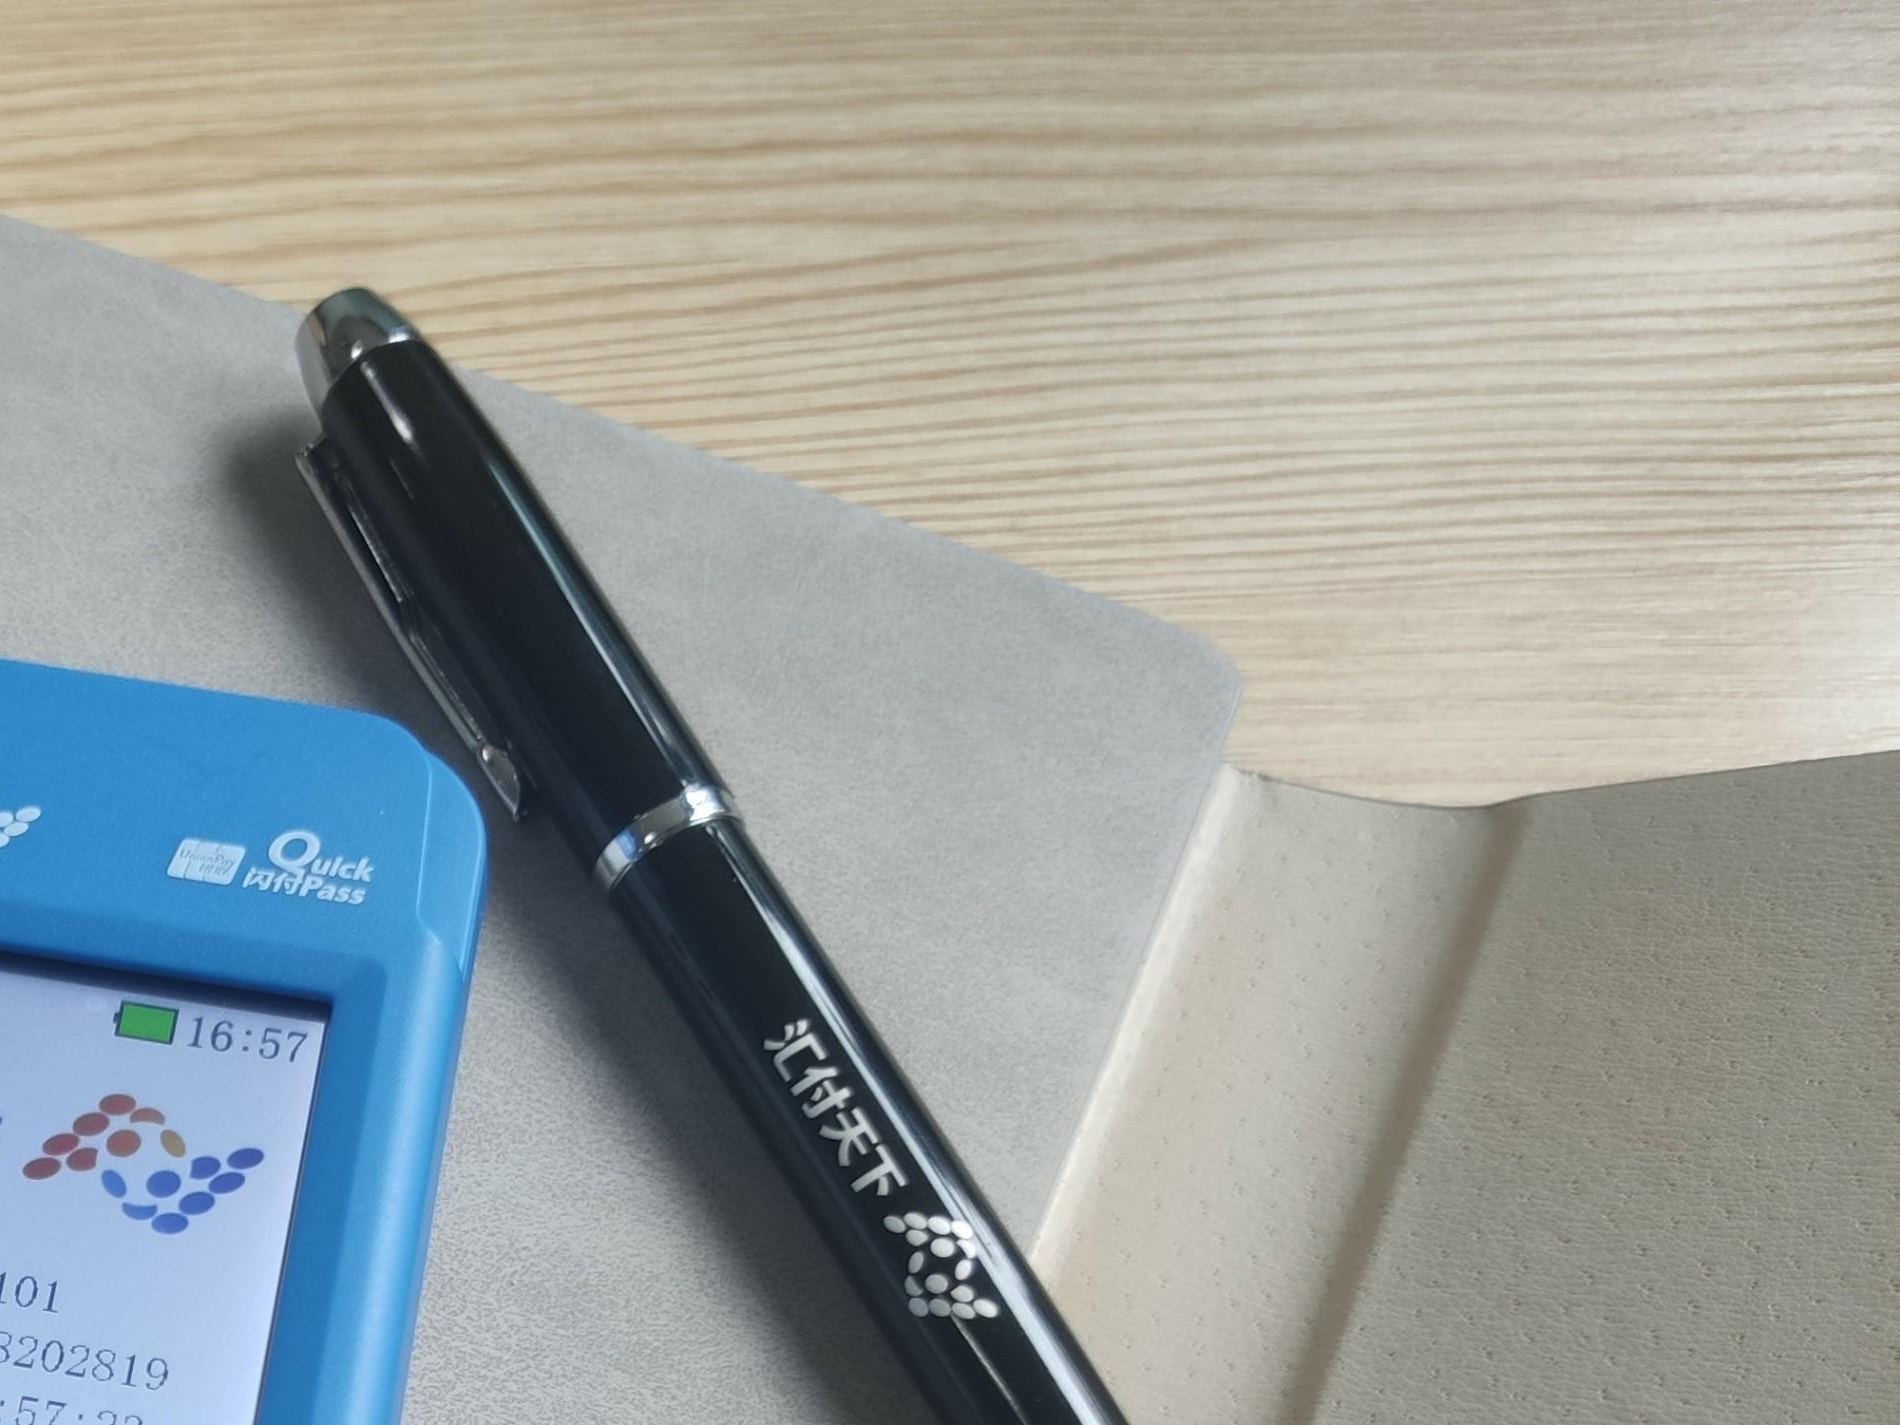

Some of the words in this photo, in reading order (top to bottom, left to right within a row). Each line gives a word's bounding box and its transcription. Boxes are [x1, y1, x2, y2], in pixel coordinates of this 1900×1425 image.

[269, 830, 374, 882] Quick
[185, 1014, 309, 1064] 16:57
[763, 1018, 908, 1196] 汇付天下
